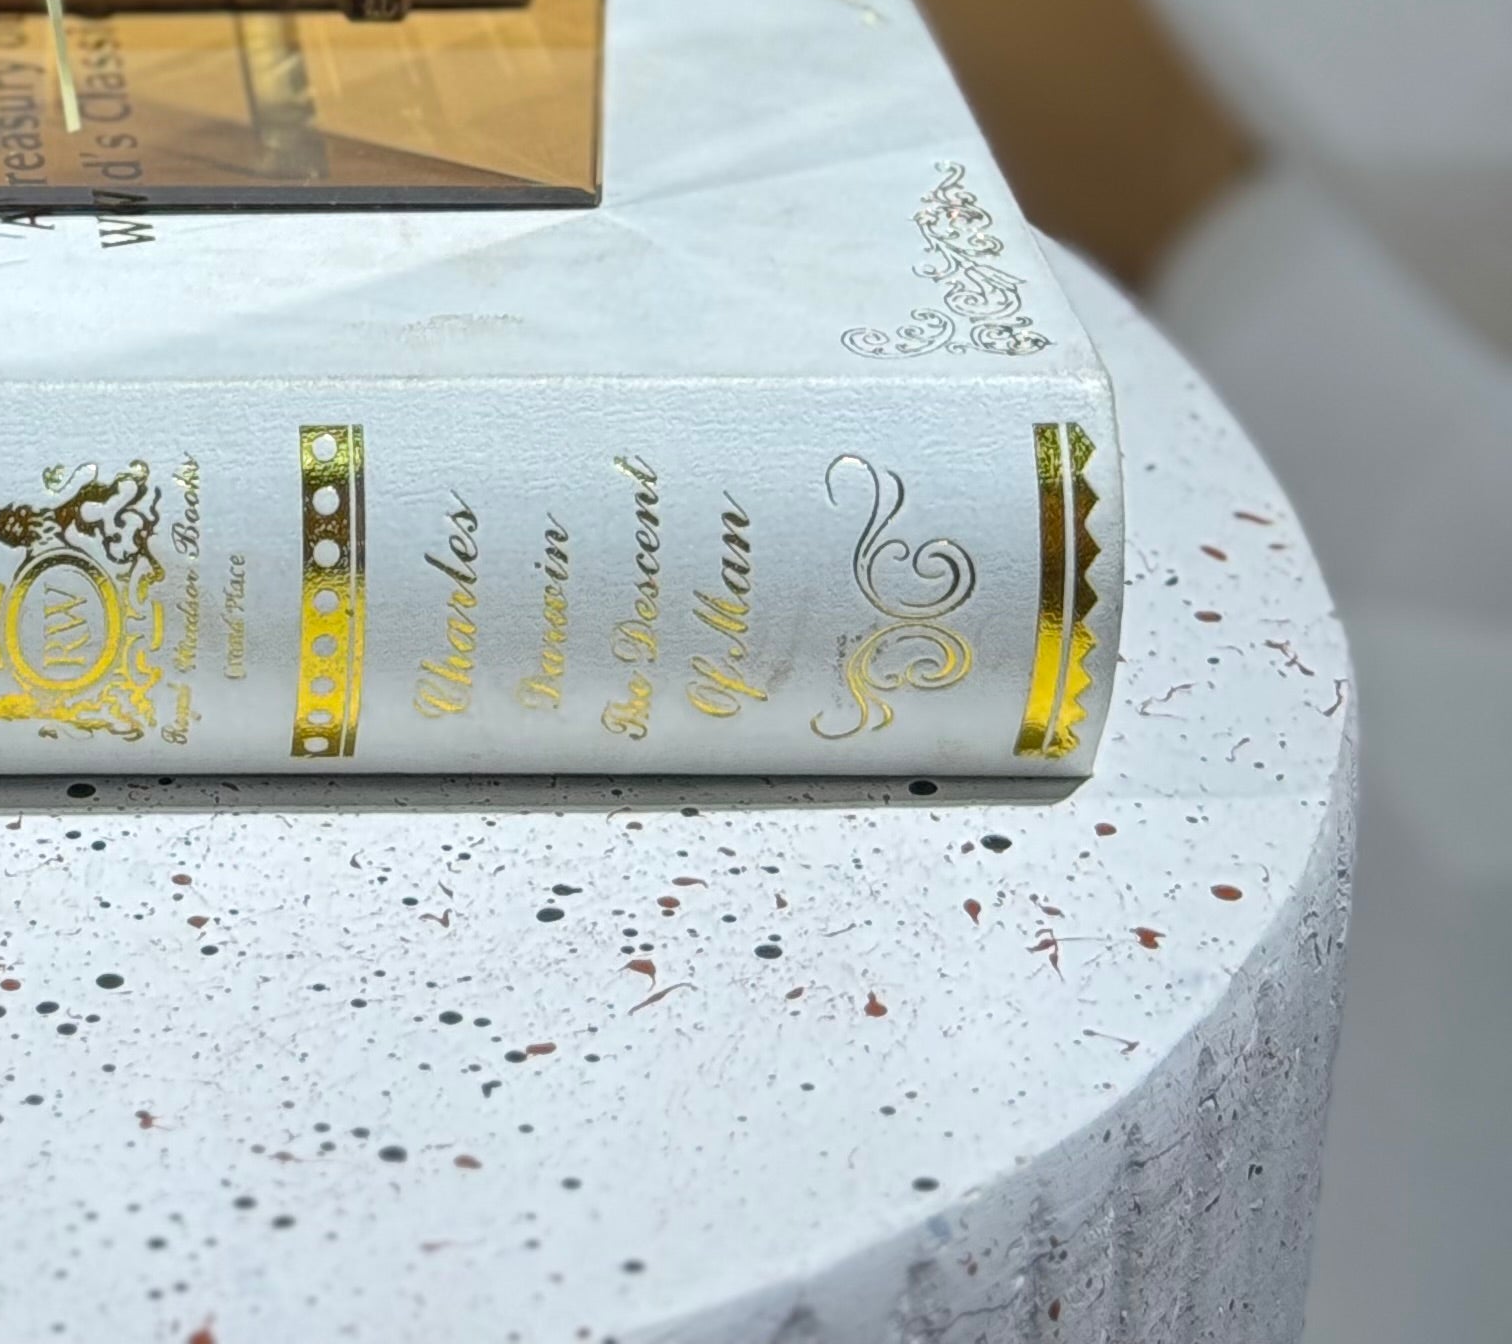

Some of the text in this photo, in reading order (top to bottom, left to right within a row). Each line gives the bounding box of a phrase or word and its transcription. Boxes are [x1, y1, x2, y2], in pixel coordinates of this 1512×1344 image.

[170, 451, 201, 561] Books
[223, 553, 247, 611] Place
[412, 488, 480, 719] Charles
[600, 454, 661, 741] The Descent
[686, 489, 769, 719] Of Man
[42, 581, 91, 668] RW
[515, 512, 570, 710] Darwin
